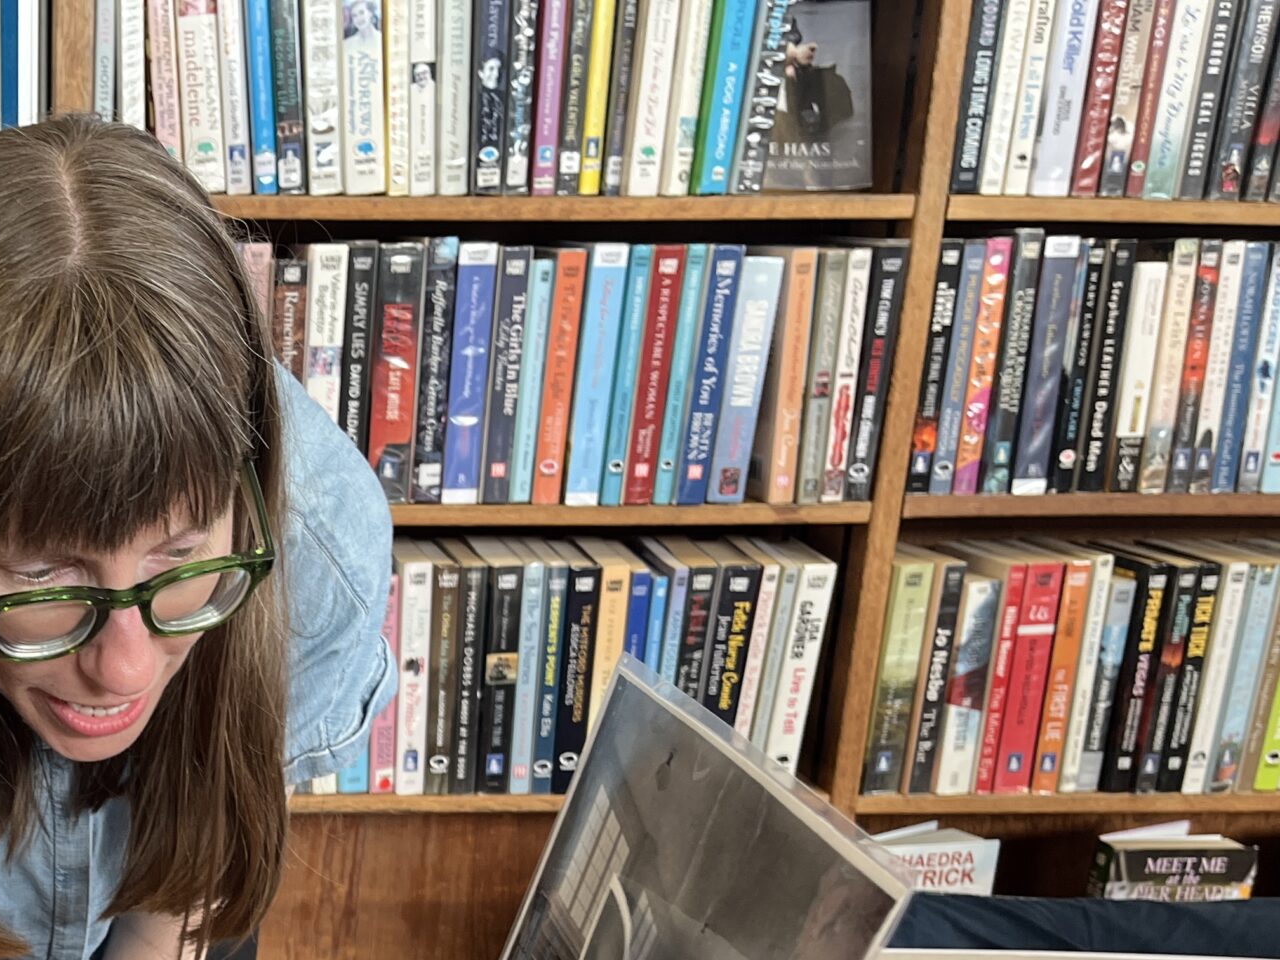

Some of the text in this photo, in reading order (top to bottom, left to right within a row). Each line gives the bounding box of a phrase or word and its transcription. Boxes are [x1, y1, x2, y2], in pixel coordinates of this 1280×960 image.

[1062, 31, 1083, 74] Killer
[1250, 5, 1272, 63] HEWSON
[184, 30, 206, 127] madeleine
[974, 51, 992, 83] LONG
[358, 52, 374, 137] ANDREWS
[969, 86, 986, 116] TIME
[1188, 24, 1228, 176] HERRON REAL TIGERS
[961, 118, 980, 168] COMING
[963, 275, 976, 320] MURDER
[650, 288, 671, 366] RESPECTABLE
[698, 278, 733, 405] Memories of You
[933, 337, 944, 354] THE
[345, 282, 368, 447] SIMPLY LIES DAVID BALDAC
[430, 336, 442, 374] Barker
[504, 293, 526, 415] The Girls In Blue
[1233, 365, 1243, 381] The
[644, 370, 660, 419] WOMAN
[730, 355, 763, 408] BROWN
[1086, 281, 1124, 472] Stephen LEATHER Dead Men
[464, 591, 477, 643] MICHAEL
[581, 604, 591, 626] THE
[716, 616, 730, 641] Jean
[1195, 596, 1214, 623] TICK
[791, 601, 813, 659] GARDNER
[935, 628, 951, 647] Jo
[1132, 589, 1162, 697] PRIVATE VEGAS
[463, 647, 474, 686] DOBBS
[545, 655, 556, 686] POINT
[725, 635, 743, 669] Nurse
[542, 694, 554, 716] Kate
[783, 668, 806, 735] Live to Tell
[990, 686, 1003, 709] The
[1049, 684, 1068, 719] FIRST
[540, 718, 552, 737] Ellis
[919, 709, 937, 737] The
[1045, 722, 1063, 742] LIE
[978, 758, 995, 781] Eye
[1144, 857, 1229, 875] MEET ME
